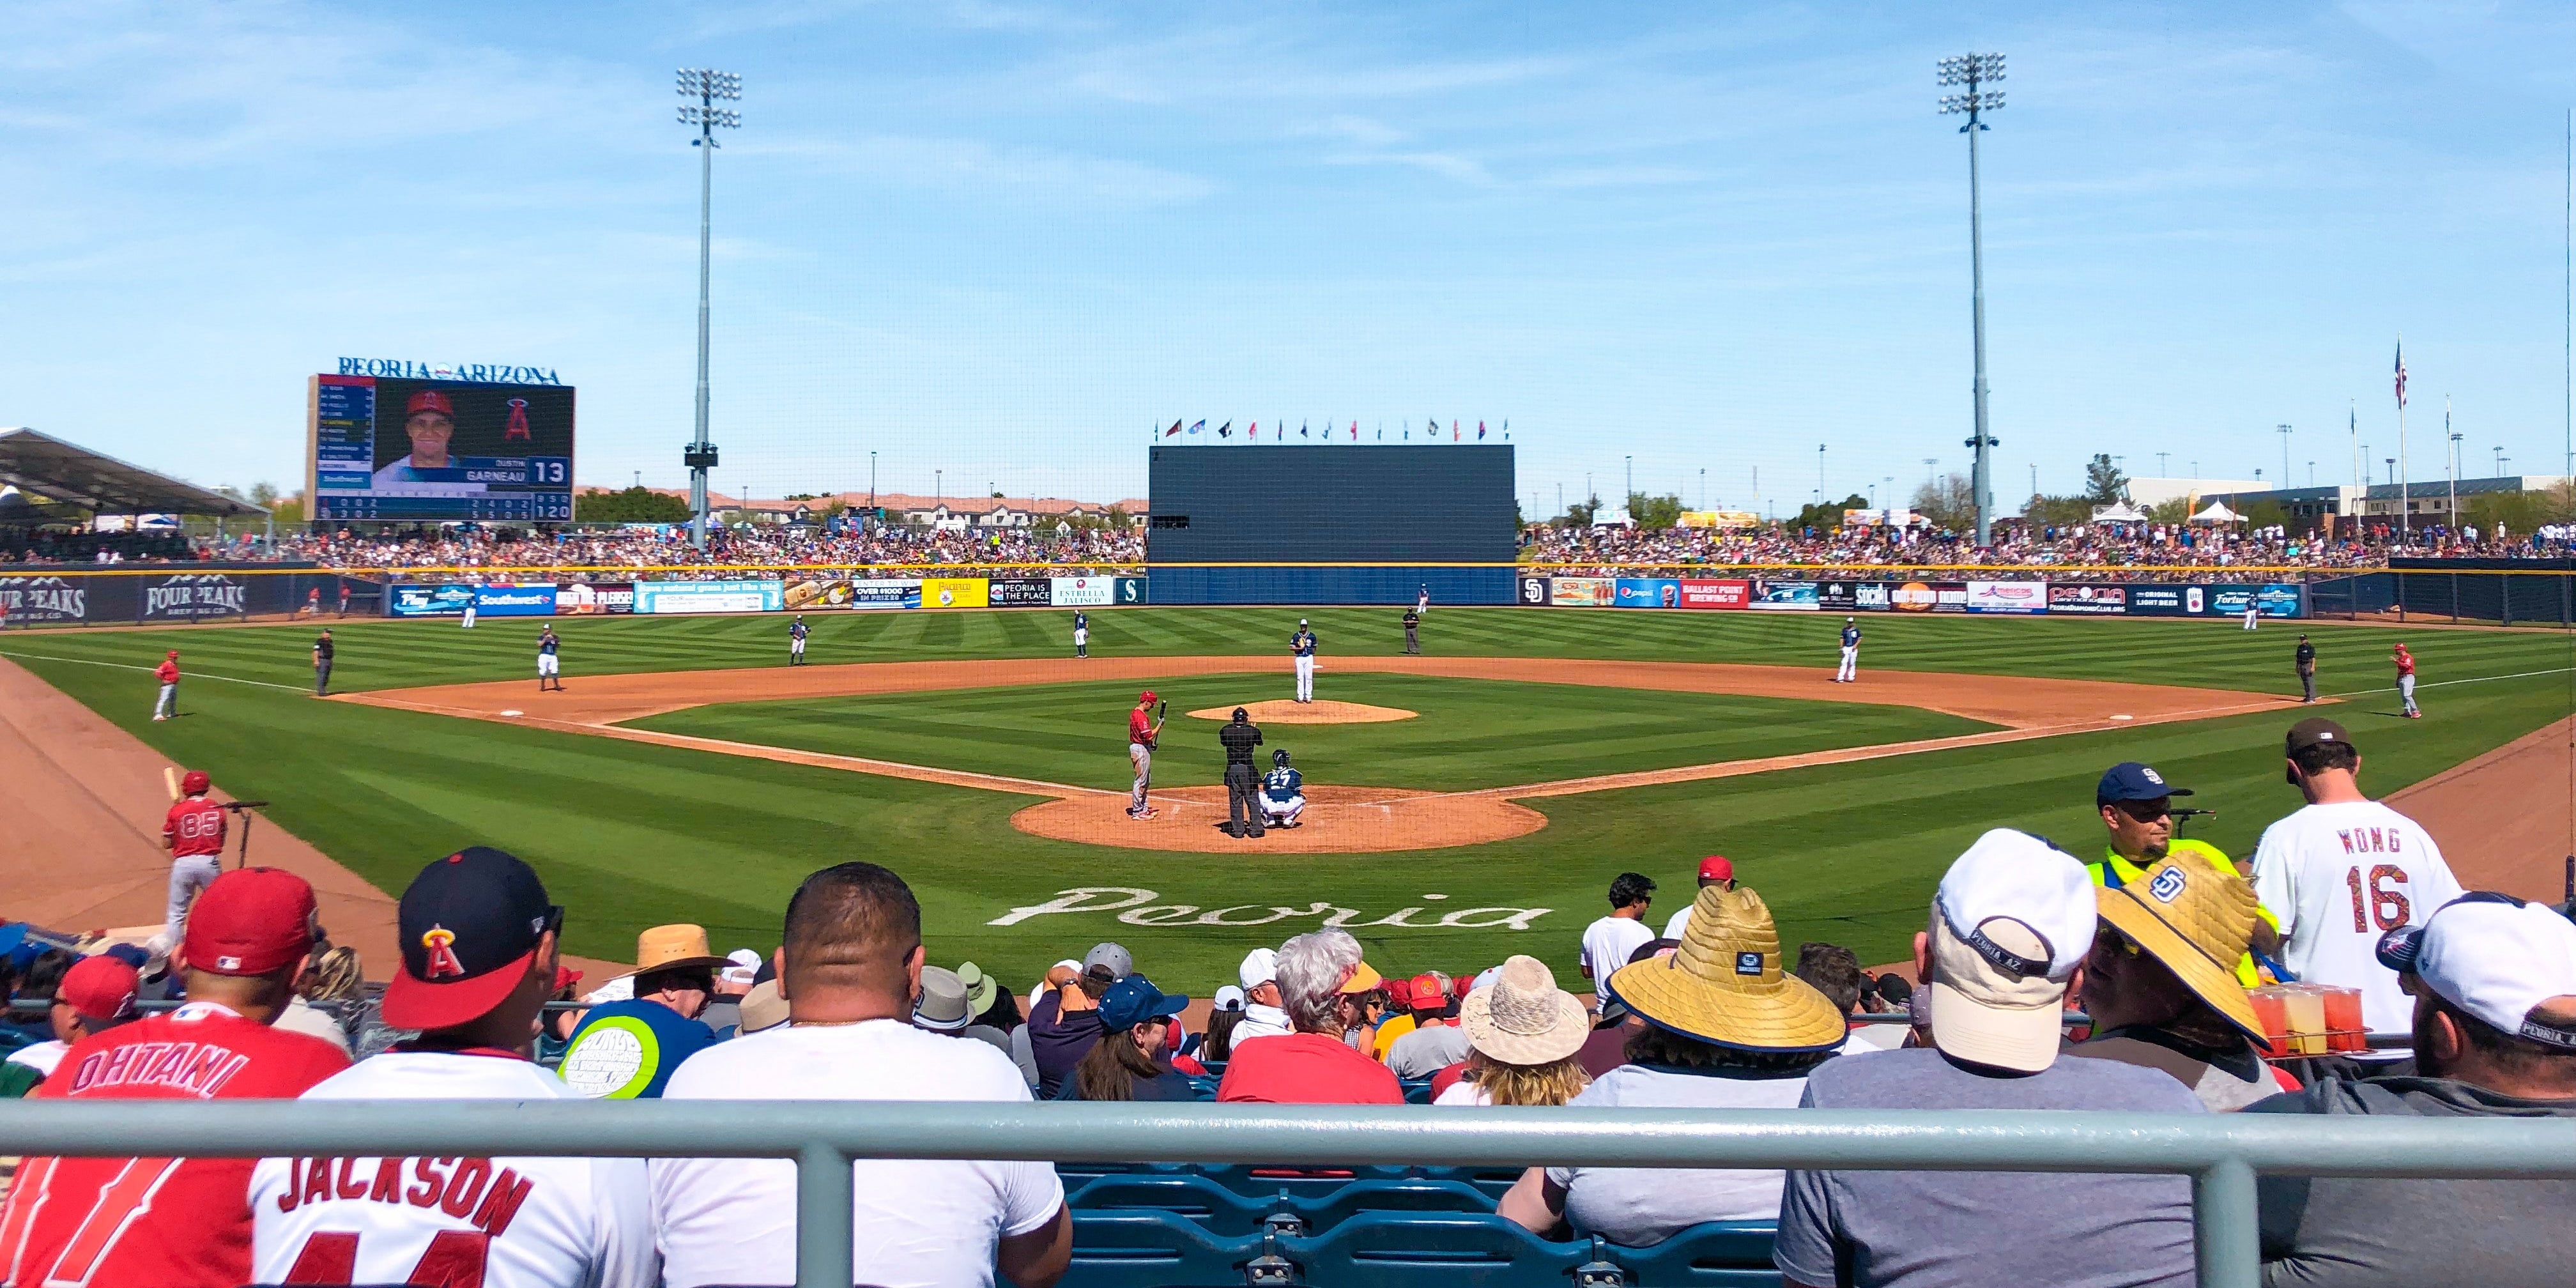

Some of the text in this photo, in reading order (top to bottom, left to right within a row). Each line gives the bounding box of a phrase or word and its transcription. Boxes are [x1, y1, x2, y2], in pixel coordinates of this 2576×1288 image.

[338, 356, 561, 385] PEORIA ARIZONA
[466, 471, 525, 482] GARNEAU
[535, 463, 564, 482] 13
[521, 500, 528, 509] 2
[548, 506, 558, 518] 2
[560, 507, 569, 518] 0
[639, 584, 662, 592] Have
[663, 584, 696, 592] natural
[697, 585, 722, 593] grass
[723, 583, 740, 593] just
[1005, 584, 1036, 592] PEORIA
[1683, 585, 1717, 594] BALLAST
[1855, 584, 1890, 604] SOCIAL
[144, 587, 192, 616] FOUR
[401, 594, 429, 609] Play
[479, 594, 543, 605] Southwest
[1689, 594, 1727, 602] BREWING
[2215, 594, 2251, 604] Fortun
[1270, 774, 1291, 790] 27
[179, 811, 221, 839] 85
[2336, 827, 2400, 855] WONG
[2347, 864, 2410, 933] 16
[985, 887, 1556, 930] Peoria
[424, 923, 466, 979] A
[68, 1042, 251, 1100] OHTANI
[277, 1157, 535, 1238] JACKSON
